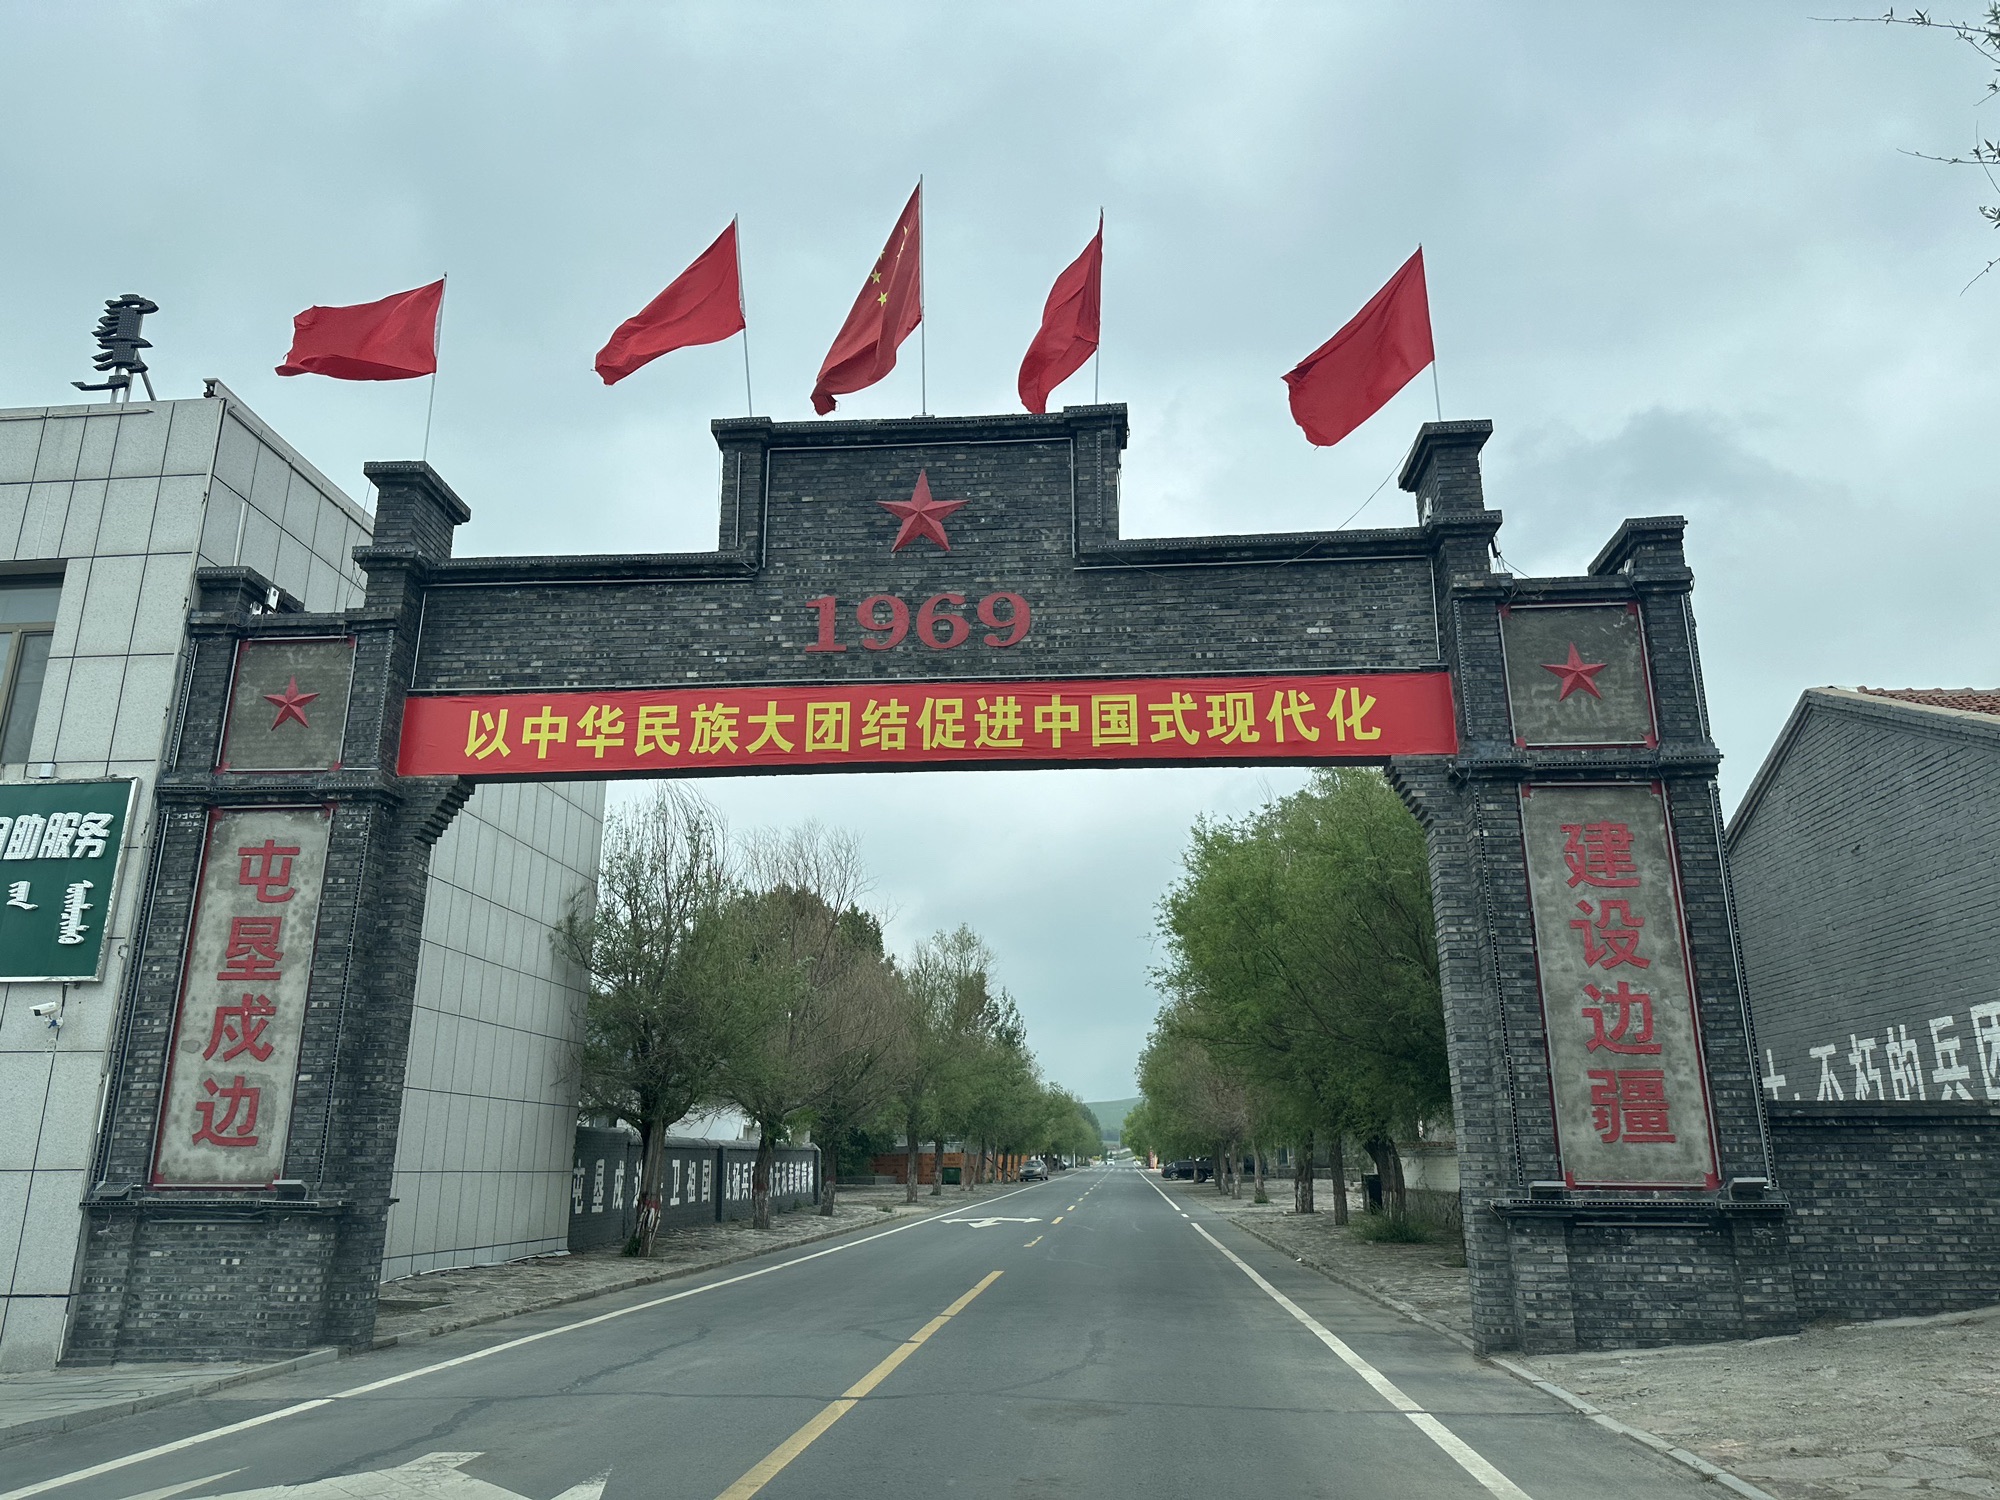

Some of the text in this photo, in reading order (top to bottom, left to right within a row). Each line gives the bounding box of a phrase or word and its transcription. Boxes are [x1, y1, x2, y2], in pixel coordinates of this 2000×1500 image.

[805, 592, 1032, 653] 1969
[463, 687, 1382, 760] 以中华民族大团结促进中国式现代化
[192, 839, 300, 1147] 屯垦戍边
[1560, 821, 1676, 1143] 建设边疆
